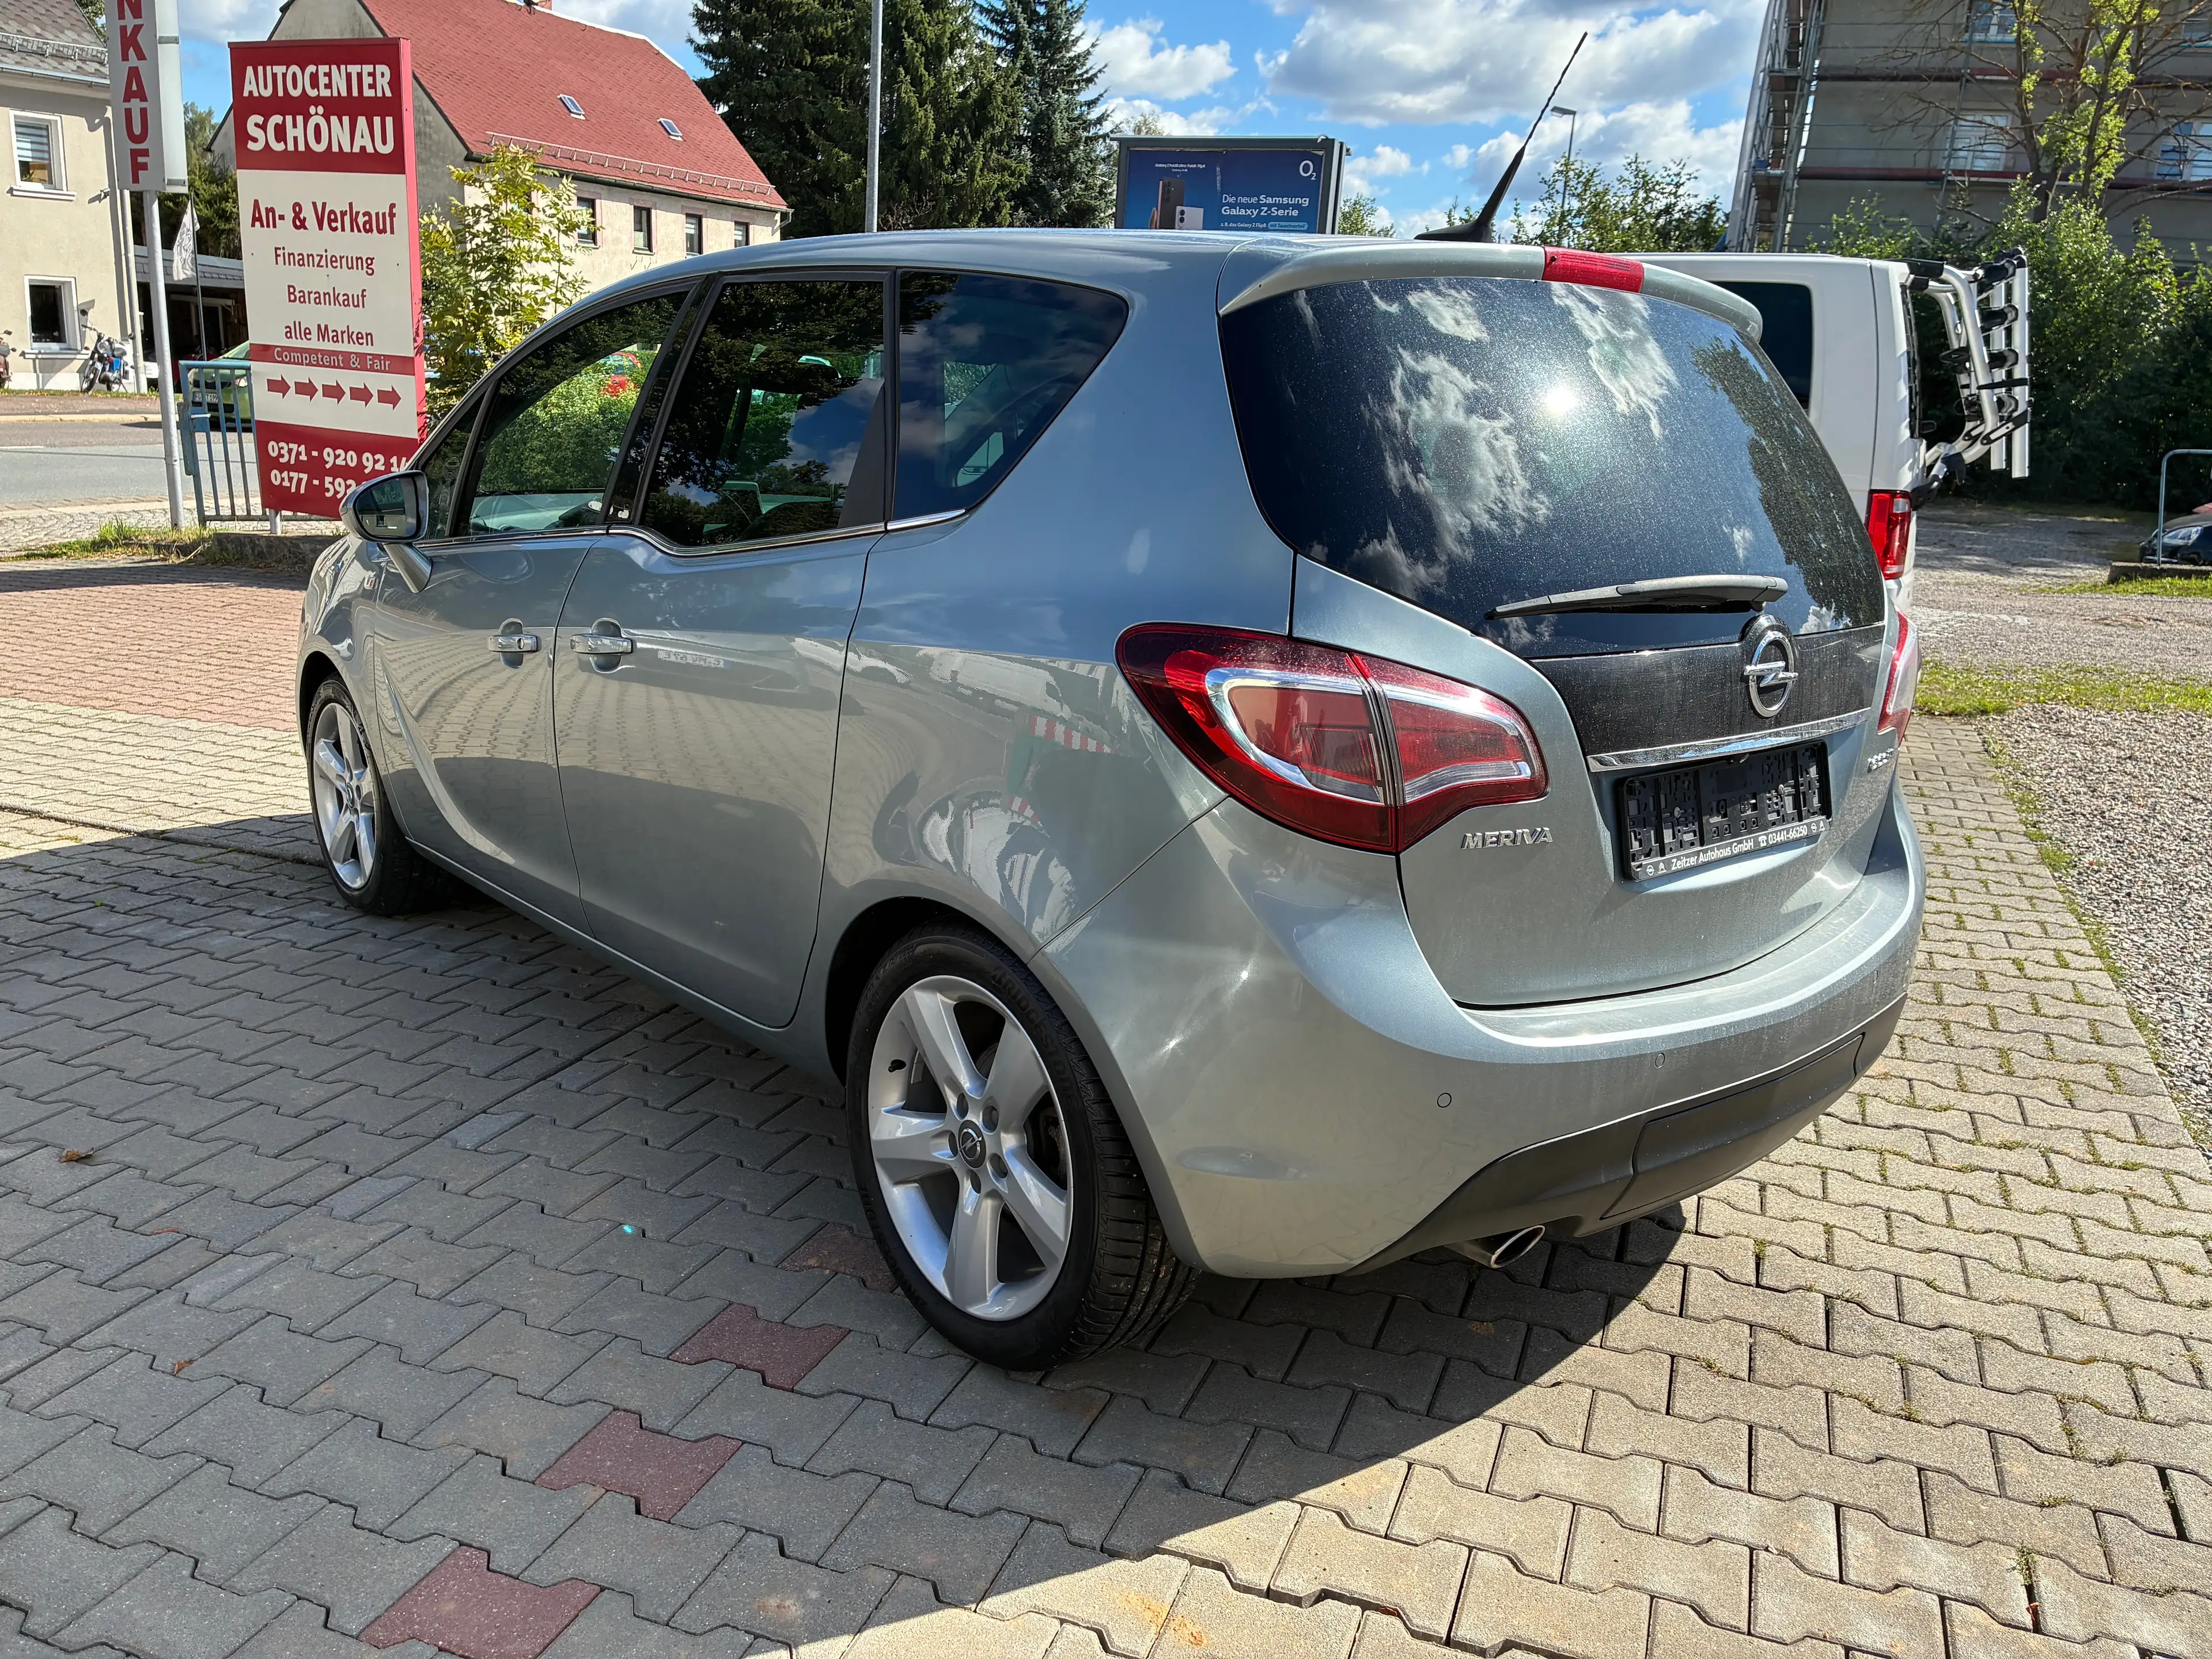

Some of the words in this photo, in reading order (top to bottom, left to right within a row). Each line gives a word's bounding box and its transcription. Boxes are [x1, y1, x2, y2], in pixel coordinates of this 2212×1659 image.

[243, 65, 392, 97] AUTOCENTER
[247, 105, 395, 154] SCHÖNAU
[1221, 207, 1259, 218] Galaxy
[1260, 207, 1299, 217] Z-Serie
[1222, 194, 1236, 204] Die
[1237, 196, 1258, 204] neue
[1259, 195, 1309, 207] Samsung
[251, 199, 285, 229] An-
[291, 202, 309, 230] &
[312, 201, 397, 235] Verkauf
[274, 247, 375, 276] Finanzierung
[287, 285, 367, 309] Barankauf
[285, 321, 312, 341] alle
[317, 323, 374, 347] Marken
[274, 347, 344, 368] Competent
[350, 354, 361, 369] &
[367, 355, 391, 371] Fair
[267, 440, 308, 465] 0371
[323, 448, 357, 469] 920
[362, 452, 385, 474] 92
[270, 469, 308, 494] 0177
[1460, 827, 1554, 850] MERIVA
[1671, 856, 1698, 870] Zeitzer
[1698, 846, 1732, 864] Autohaus
[1732, 838, 1754, 854] GmbH
[1768, 825, 1808, 846] 03441-66250
